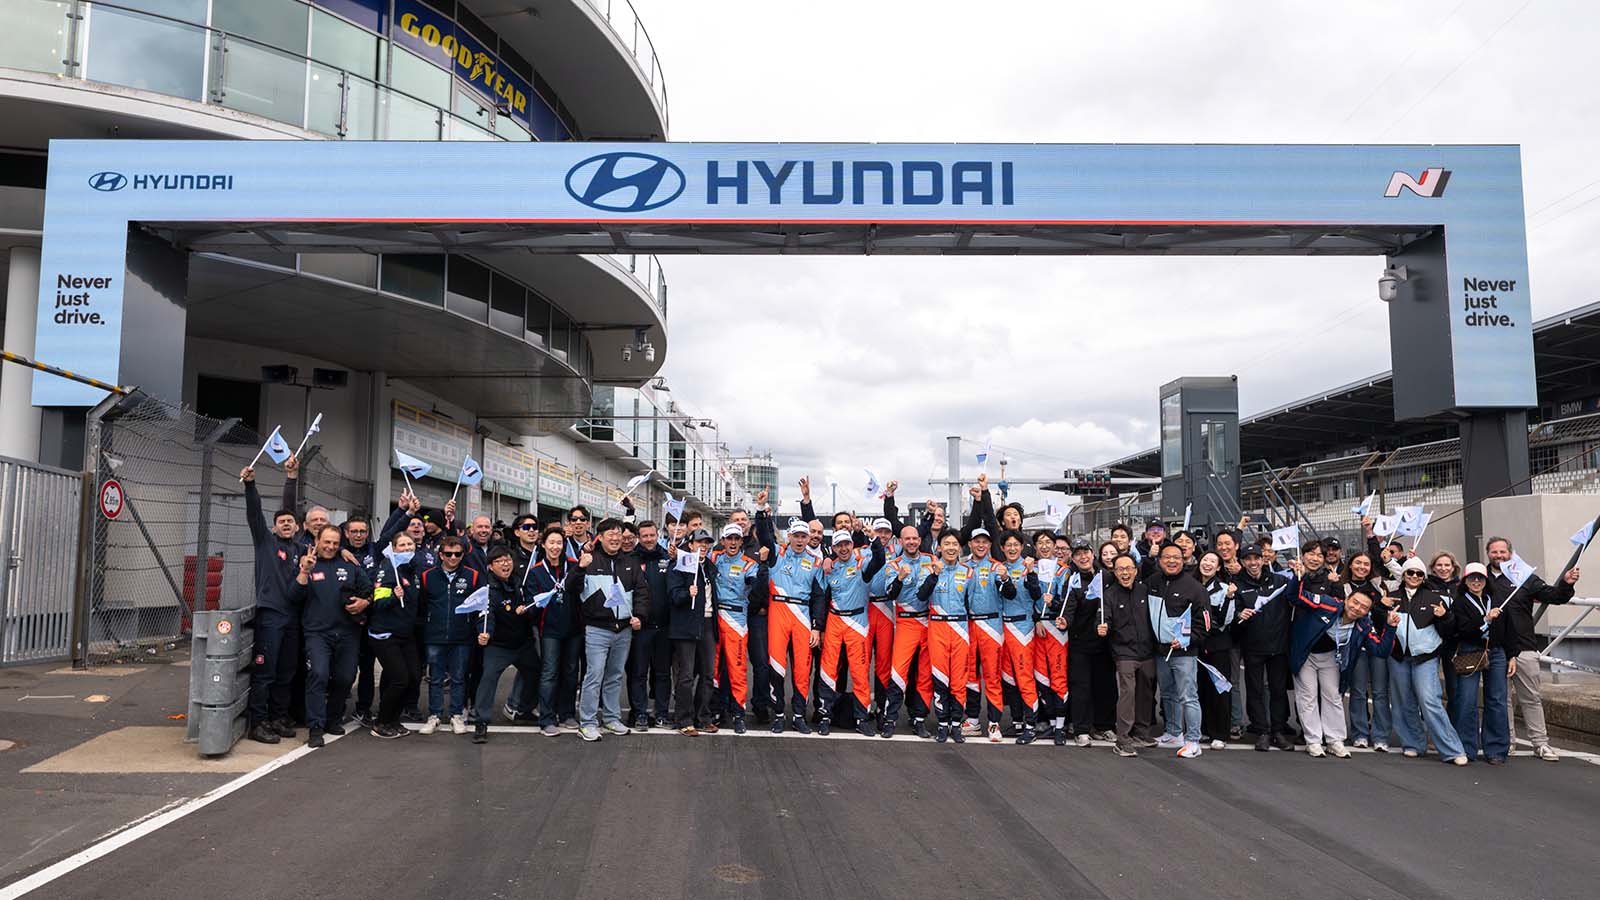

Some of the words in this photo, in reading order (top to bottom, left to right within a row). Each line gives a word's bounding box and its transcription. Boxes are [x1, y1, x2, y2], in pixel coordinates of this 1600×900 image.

[400, 12, 527, 114] GOODYEAR
[133, 174, 233, 190] HYUNDAI
[706, 160, 1014, 205] HYUNDAI
[57, 273, 112, 289] Never
[1463, 277, 1516, 292] Never
[55, 290, 90, 308] just
[1464, 293, 1498, 311] just
[54, 308, 105, 325] drive.
[1465, 311, 1515, 328] drive.
[1560, 400, 1583, 415] BMW
